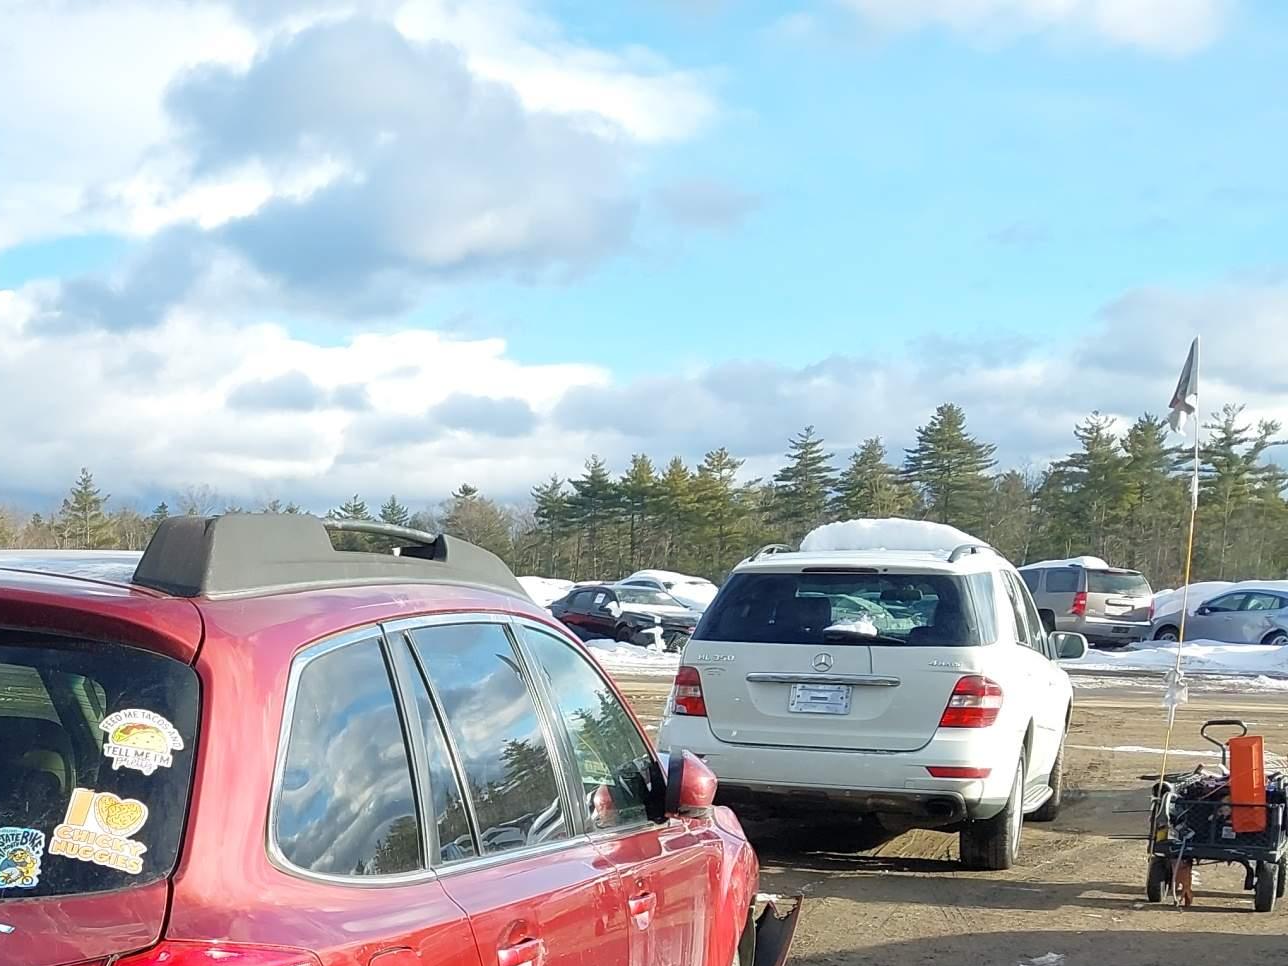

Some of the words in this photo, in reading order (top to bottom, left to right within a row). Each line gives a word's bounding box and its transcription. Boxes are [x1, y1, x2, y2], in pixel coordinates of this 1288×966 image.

[102, 714, 122, 729] FEED
[124, 711, 139, 719] ME
[142, 711, 170, 730] TACOS
[168, 730, 182, 748] AND
[106, 746, 130, 758] TELL
[134, 750, 151, 760] ME
[153, 754, 170, 765] I'M
[67, 788, 95, 827] I
[20, 830, 42, 851] BIKE
[50, 840, 140, 872] NUGGIES
[56, 825, 141, 857] CHICKY
